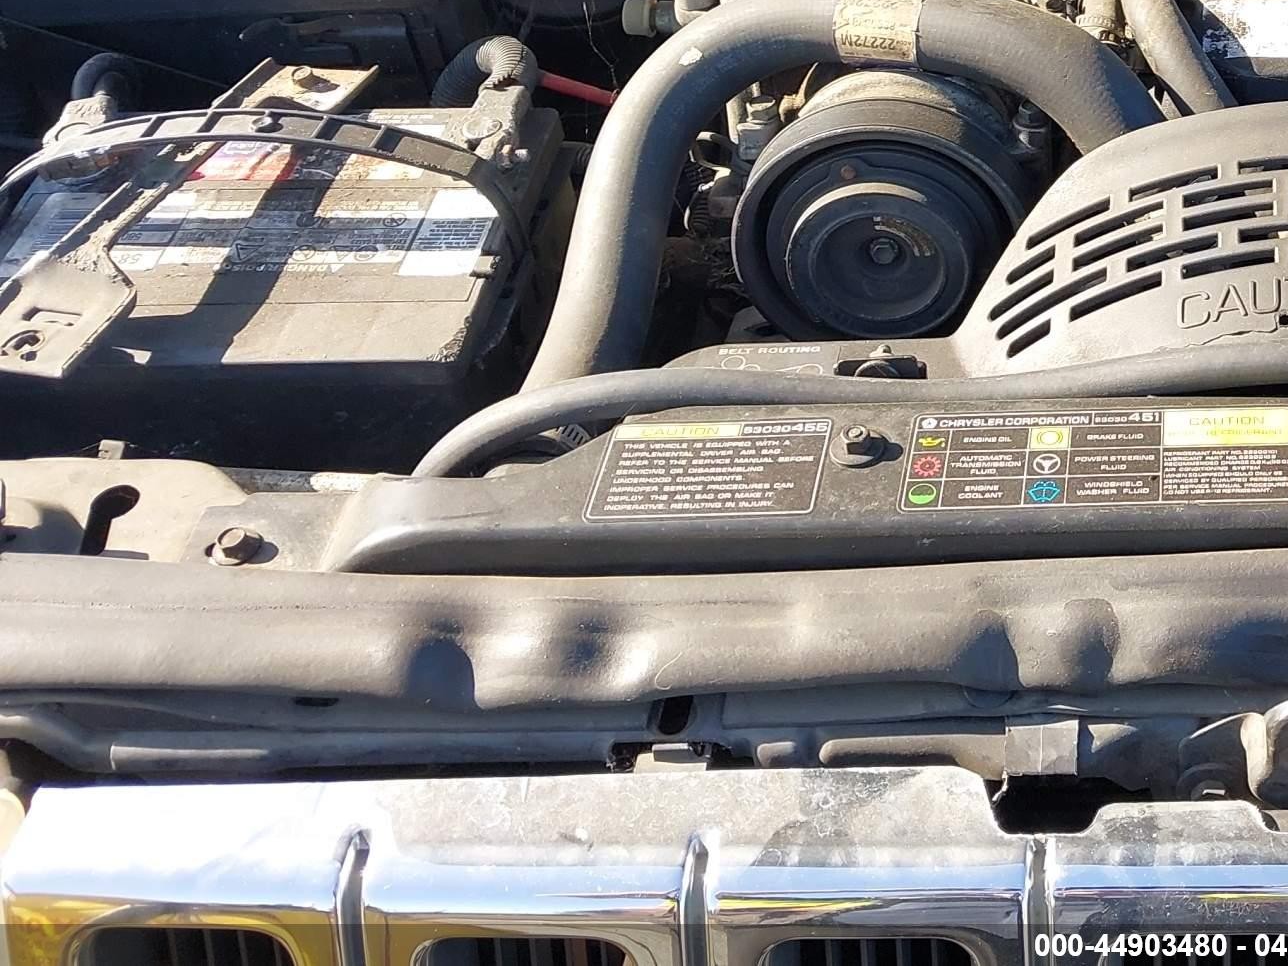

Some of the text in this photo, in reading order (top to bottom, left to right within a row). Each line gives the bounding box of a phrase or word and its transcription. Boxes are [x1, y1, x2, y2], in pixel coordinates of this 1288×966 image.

[841, 34, 896, 51] 22272M
[718, 346, 821, 355] BELT ROUTING
[940, 416, 1089, 427] CHRYSLER CORPORATION
[1084, 480, 1143, 488] WINDSHIELD
[958, 491, 1003, 499] COOLANT
